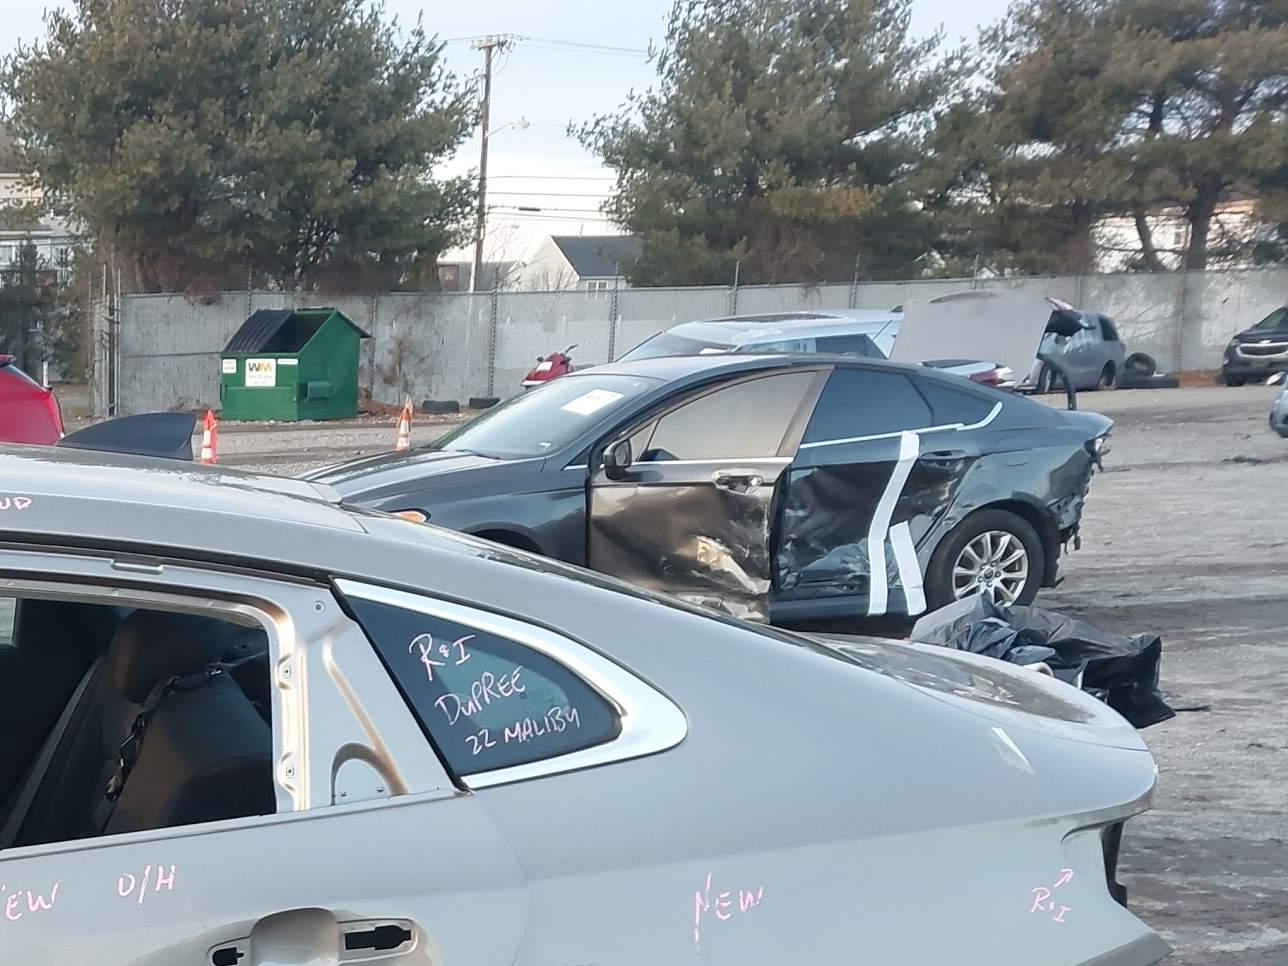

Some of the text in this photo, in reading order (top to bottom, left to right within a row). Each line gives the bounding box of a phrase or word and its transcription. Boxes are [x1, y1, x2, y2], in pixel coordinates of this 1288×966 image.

[465, 728, 496, 755] 22
[117, 864, 177, 908] O/H
[694, 872, 764, 944] NEW
